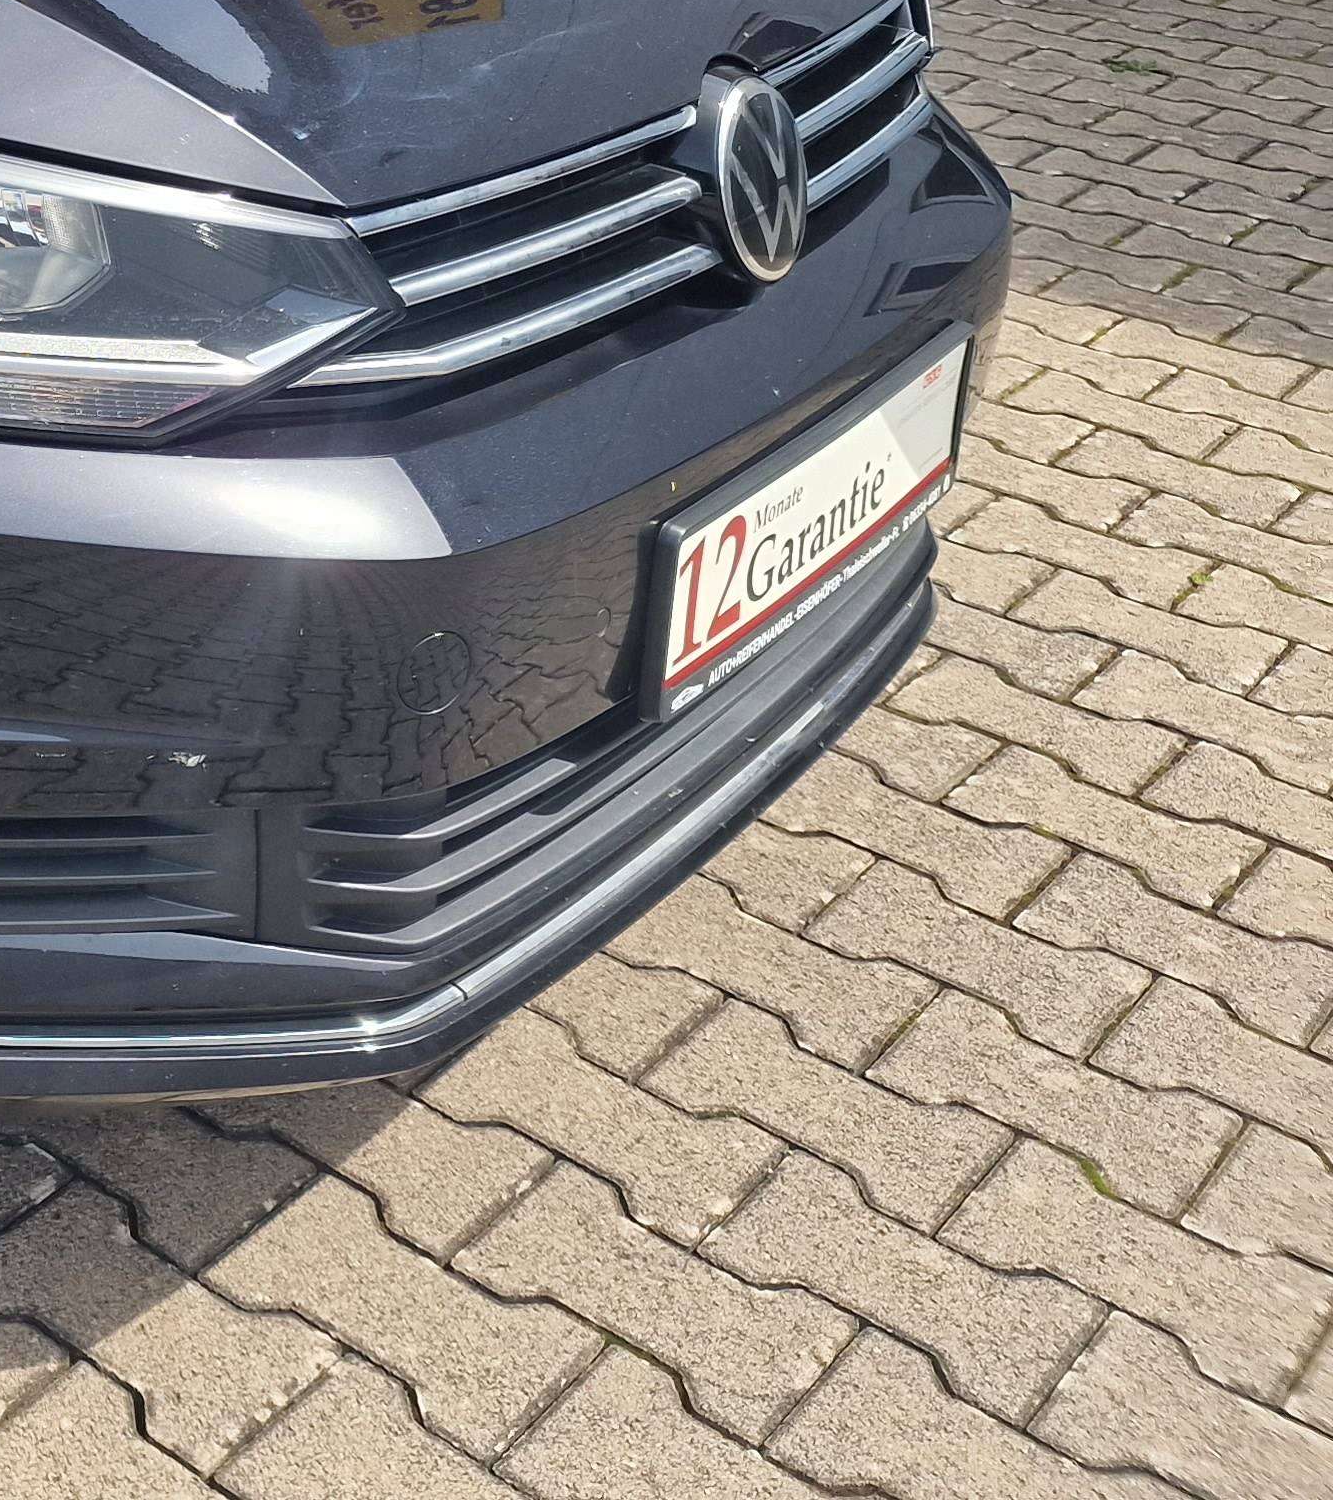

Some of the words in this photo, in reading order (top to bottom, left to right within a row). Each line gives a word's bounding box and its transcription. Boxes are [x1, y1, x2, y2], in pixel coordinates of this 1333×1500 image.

[746, 461, 886, 603] Garantie
[753, 483, 804, 534] Monate
[672, 514, 747, 667] 12
